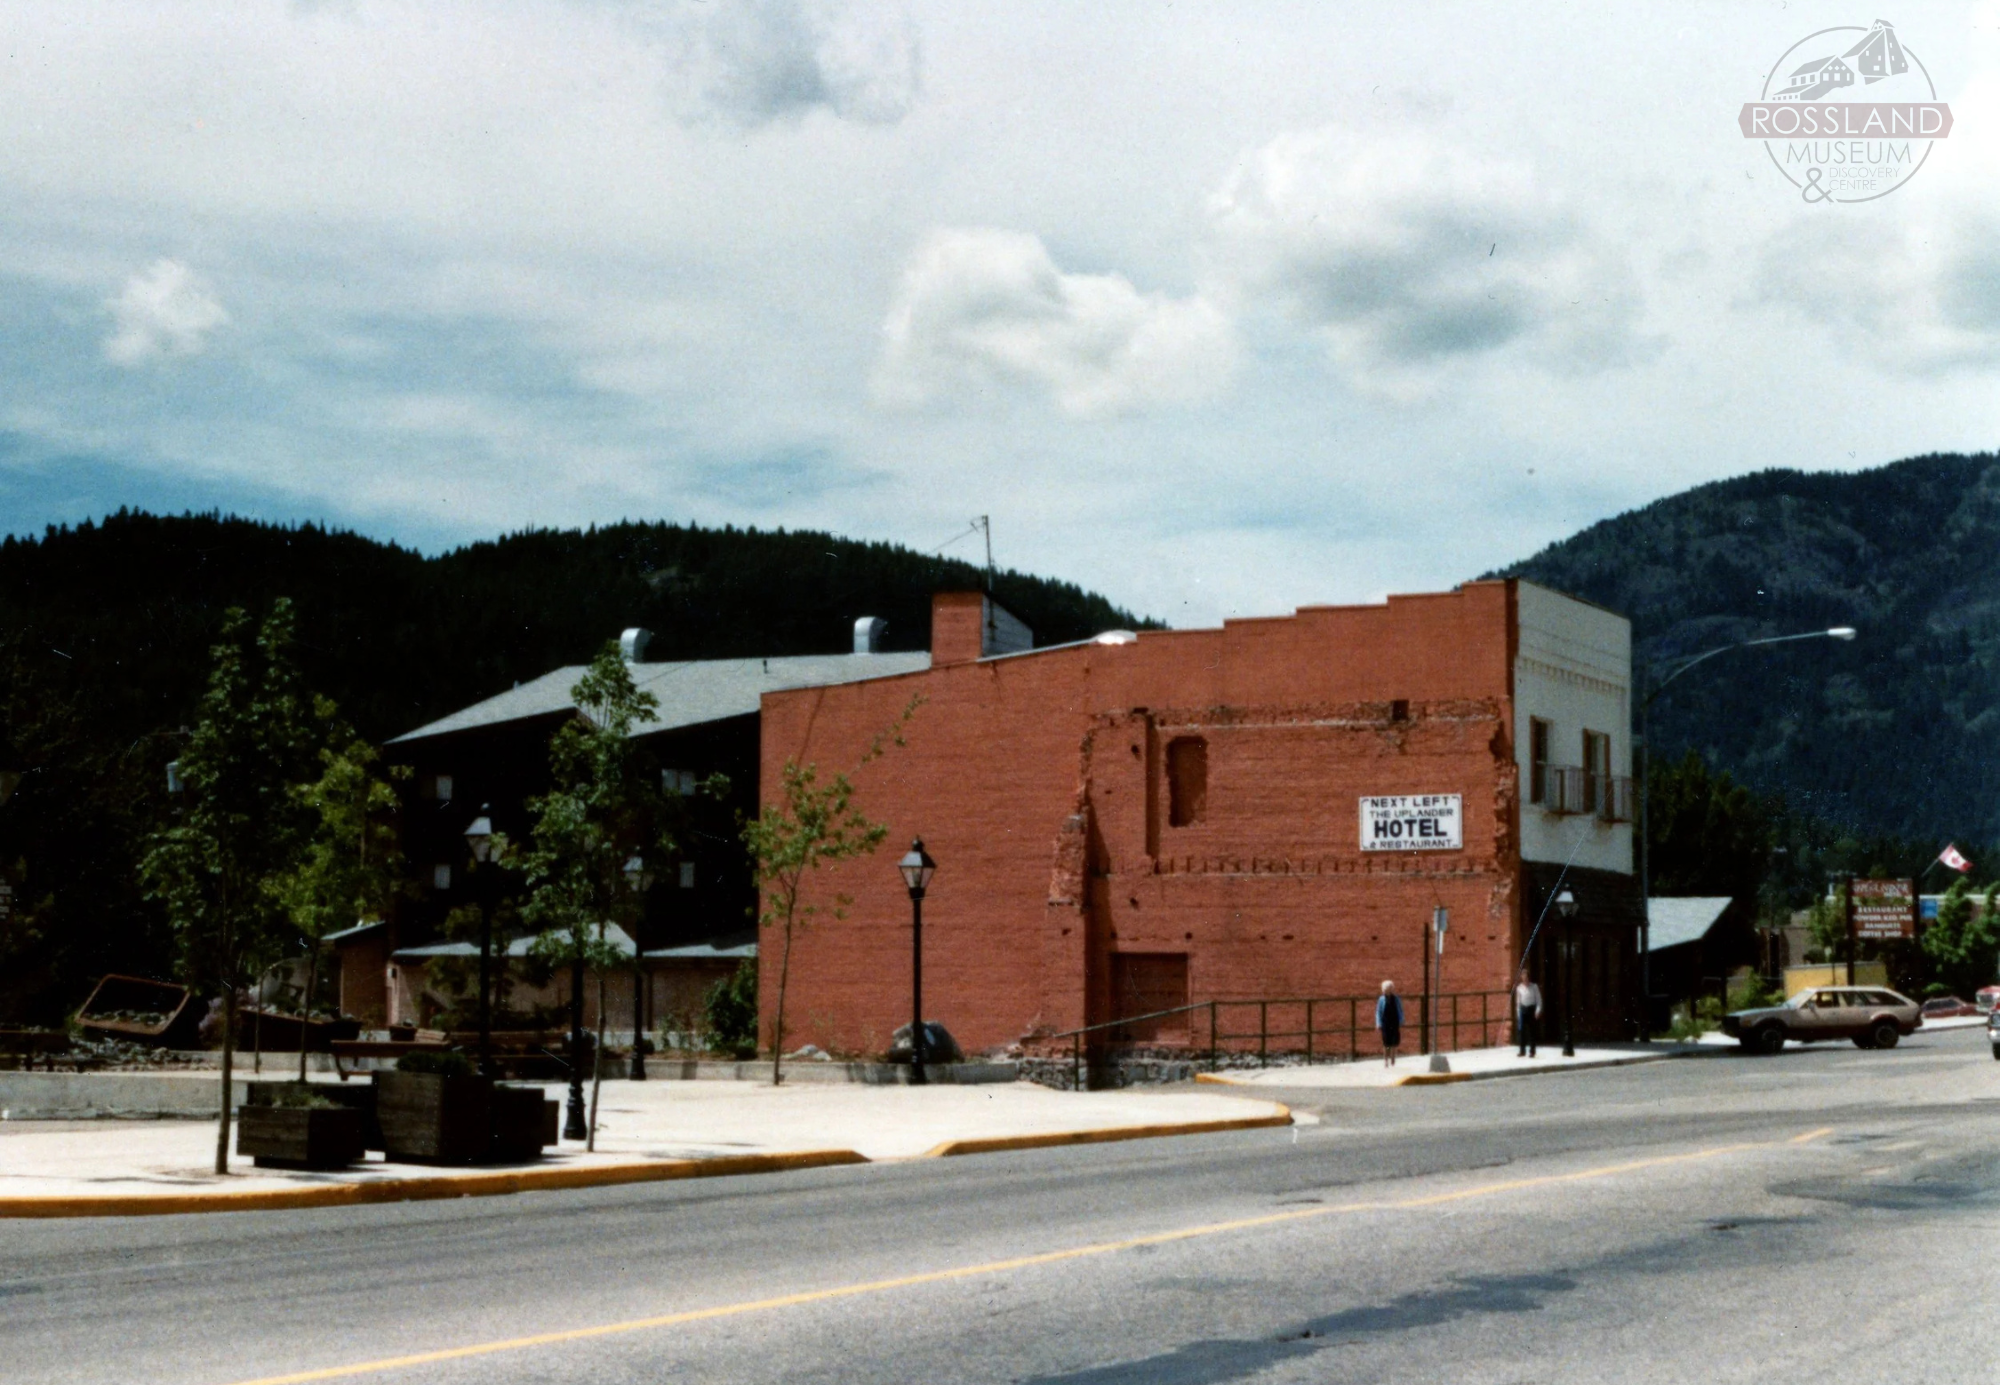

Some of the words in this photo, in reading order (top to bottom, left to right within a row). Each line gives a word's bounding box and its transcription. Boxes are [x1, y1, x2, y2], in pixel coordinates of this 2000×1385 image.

[1370, 797, 1407, 808] NEXT
[1413, 796, 1449, 807] LEFT
[1369, 810, 1391, 819] THE
[1394, 808, 1454, 818] UPLANDER
[1374, 818, 1447, 838] HOTEL
[1370, 841, 1376, 849] &
[1379, 839, 1452, 849] RESTAURANT
